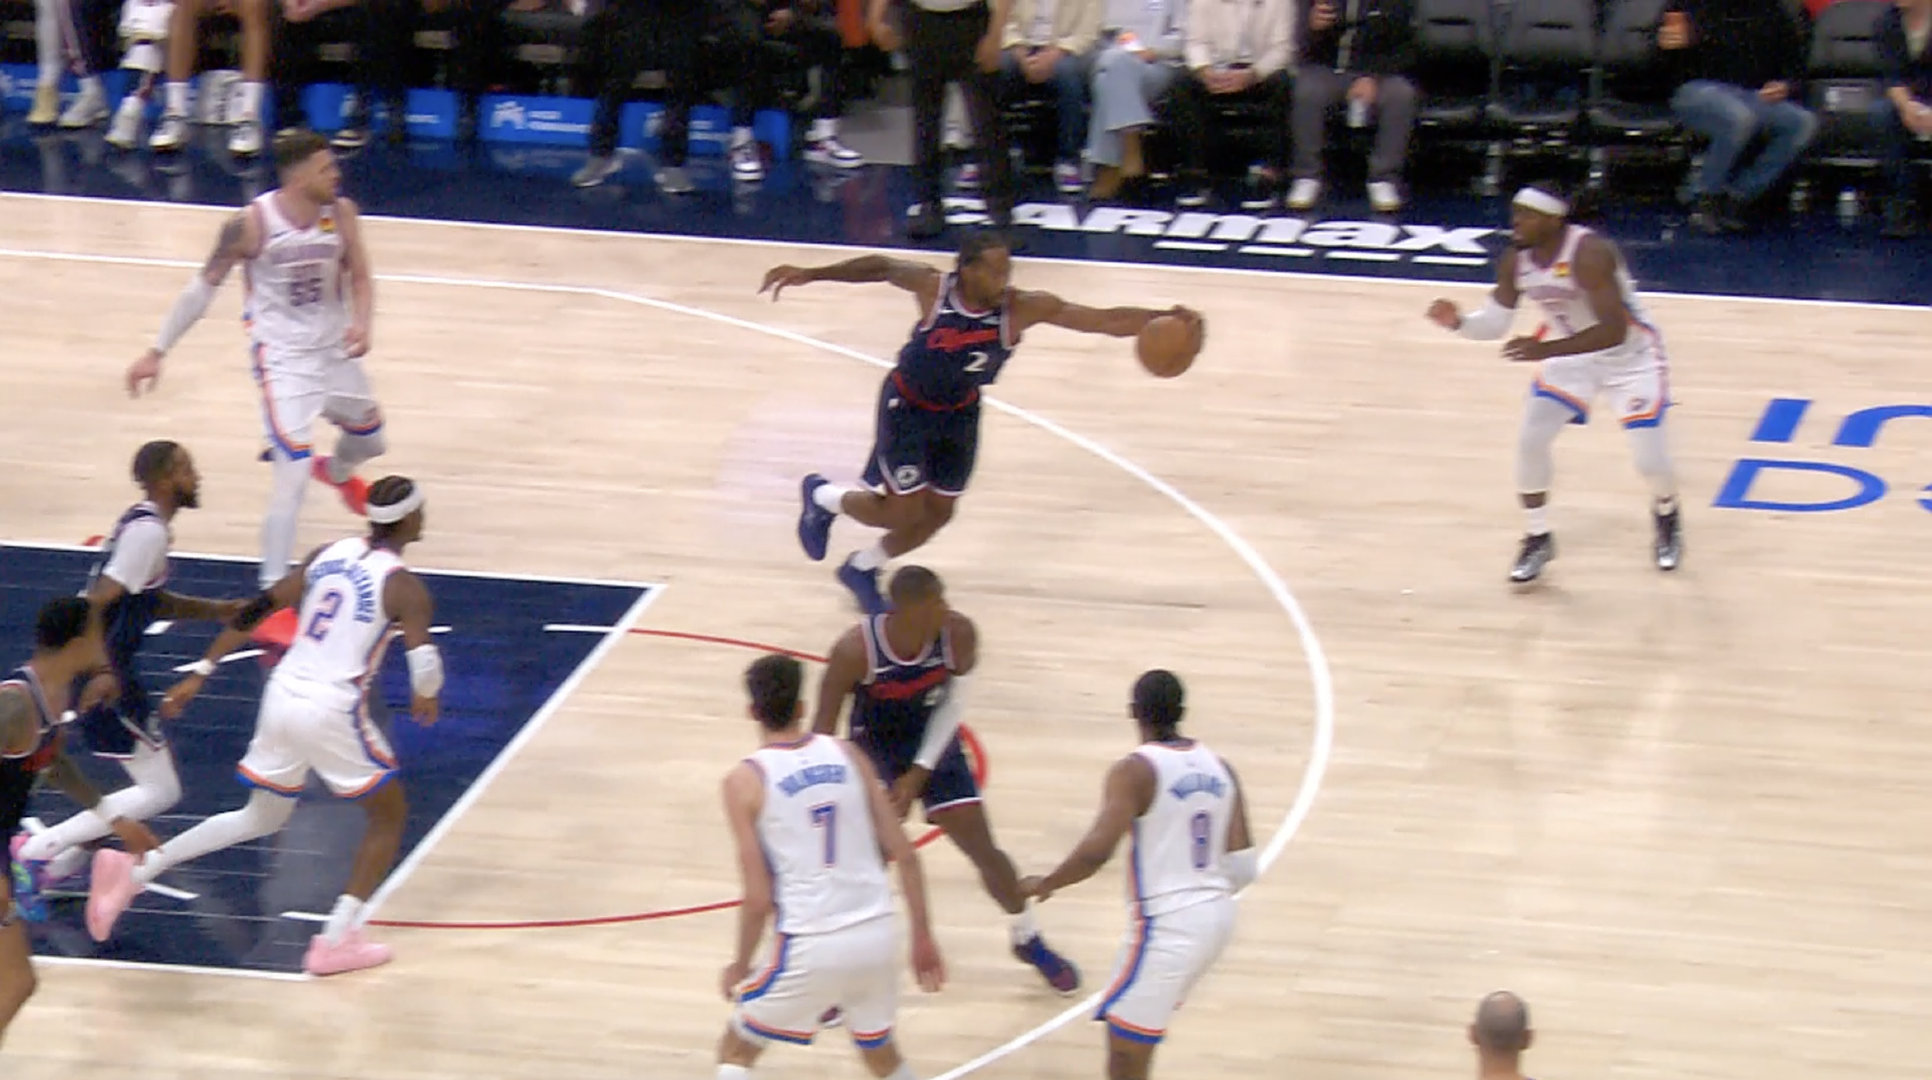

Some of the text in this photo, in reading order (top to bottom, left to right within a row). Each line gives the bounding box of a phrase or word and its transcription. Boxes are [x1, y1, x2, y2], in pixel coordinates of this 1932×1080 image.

[962, 351, 989, 372] 2
[1709, 457, 1932, 514] D
[304, 588, 343, 642] 2
[807, 801, 837, 868] 7
[1189, 809, 1212, 871] 8
